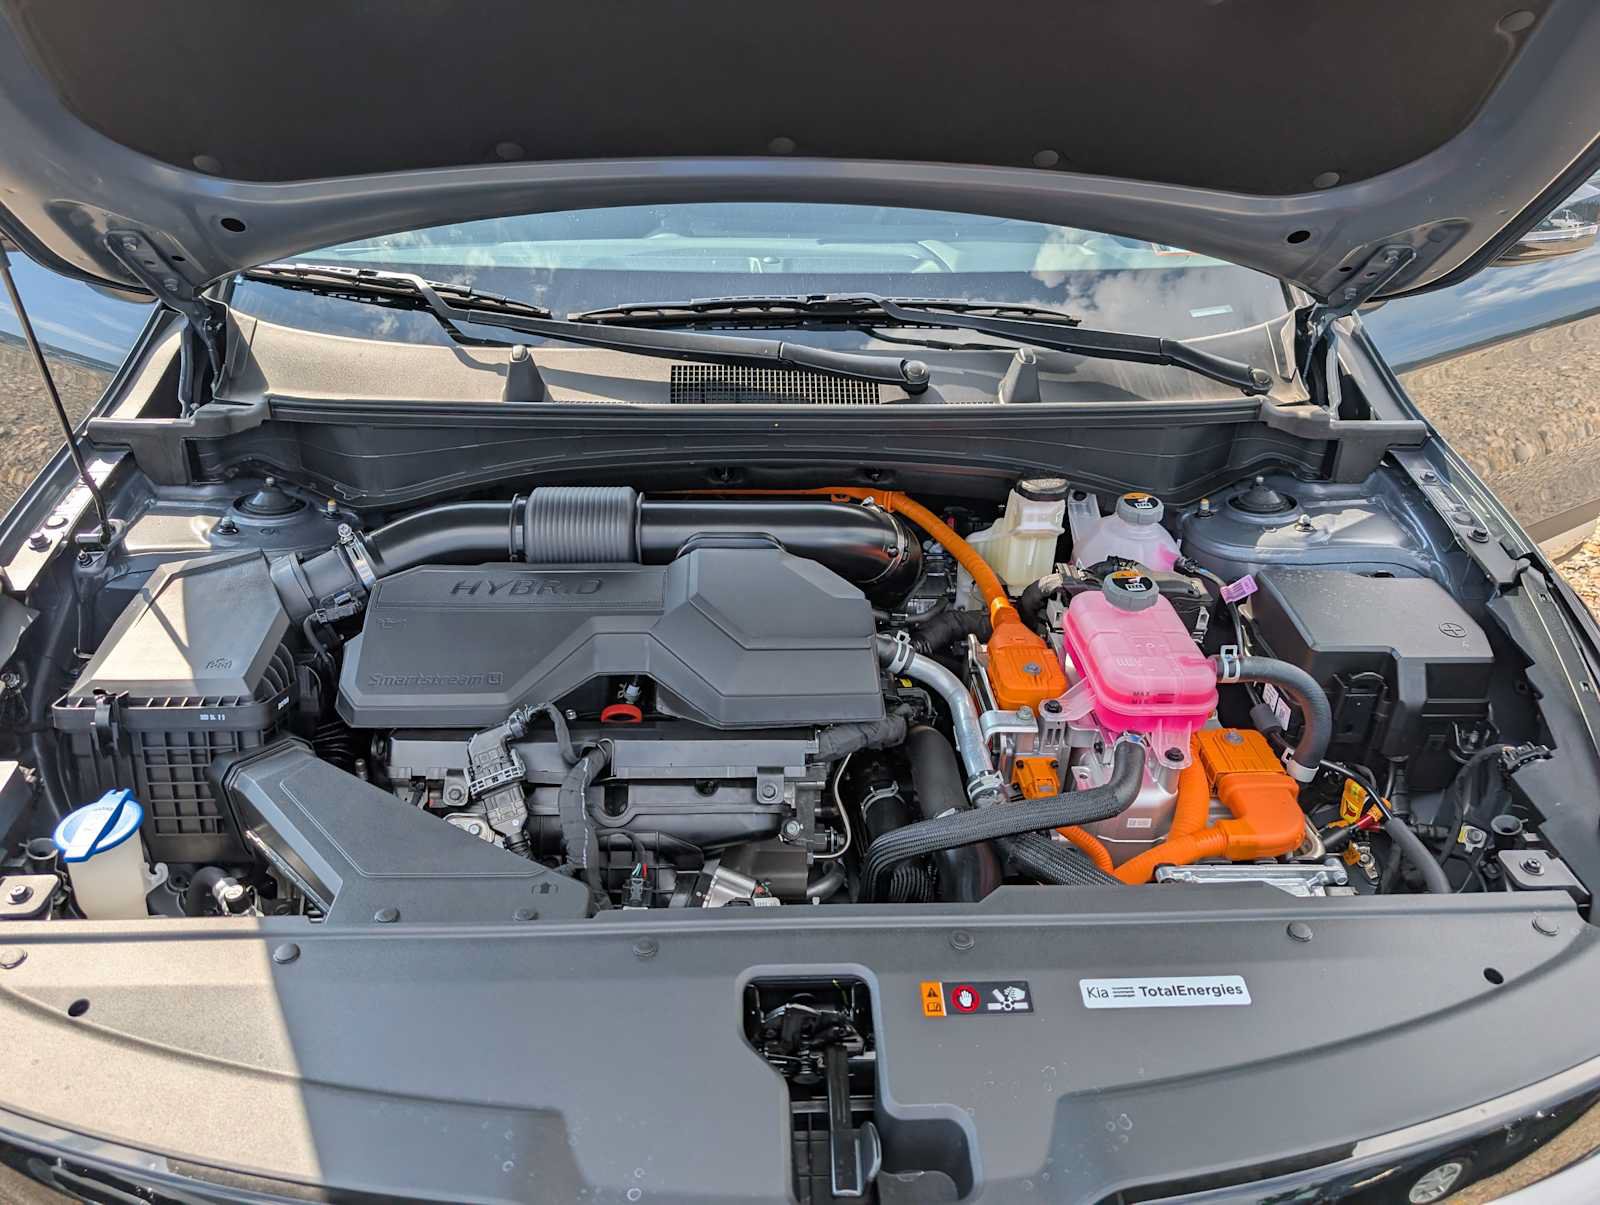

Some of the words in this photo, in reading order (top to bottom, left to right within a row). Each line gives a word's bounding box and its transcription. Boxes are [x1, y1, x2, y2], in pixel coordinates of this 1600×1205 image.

[450, 578, 604, 596] HYBRD
[368, 672, 484, 688] Smartstream
[1086, 986, 1110, 999] Kia
[1139, 984, 1244, 998] TotalEnergies
